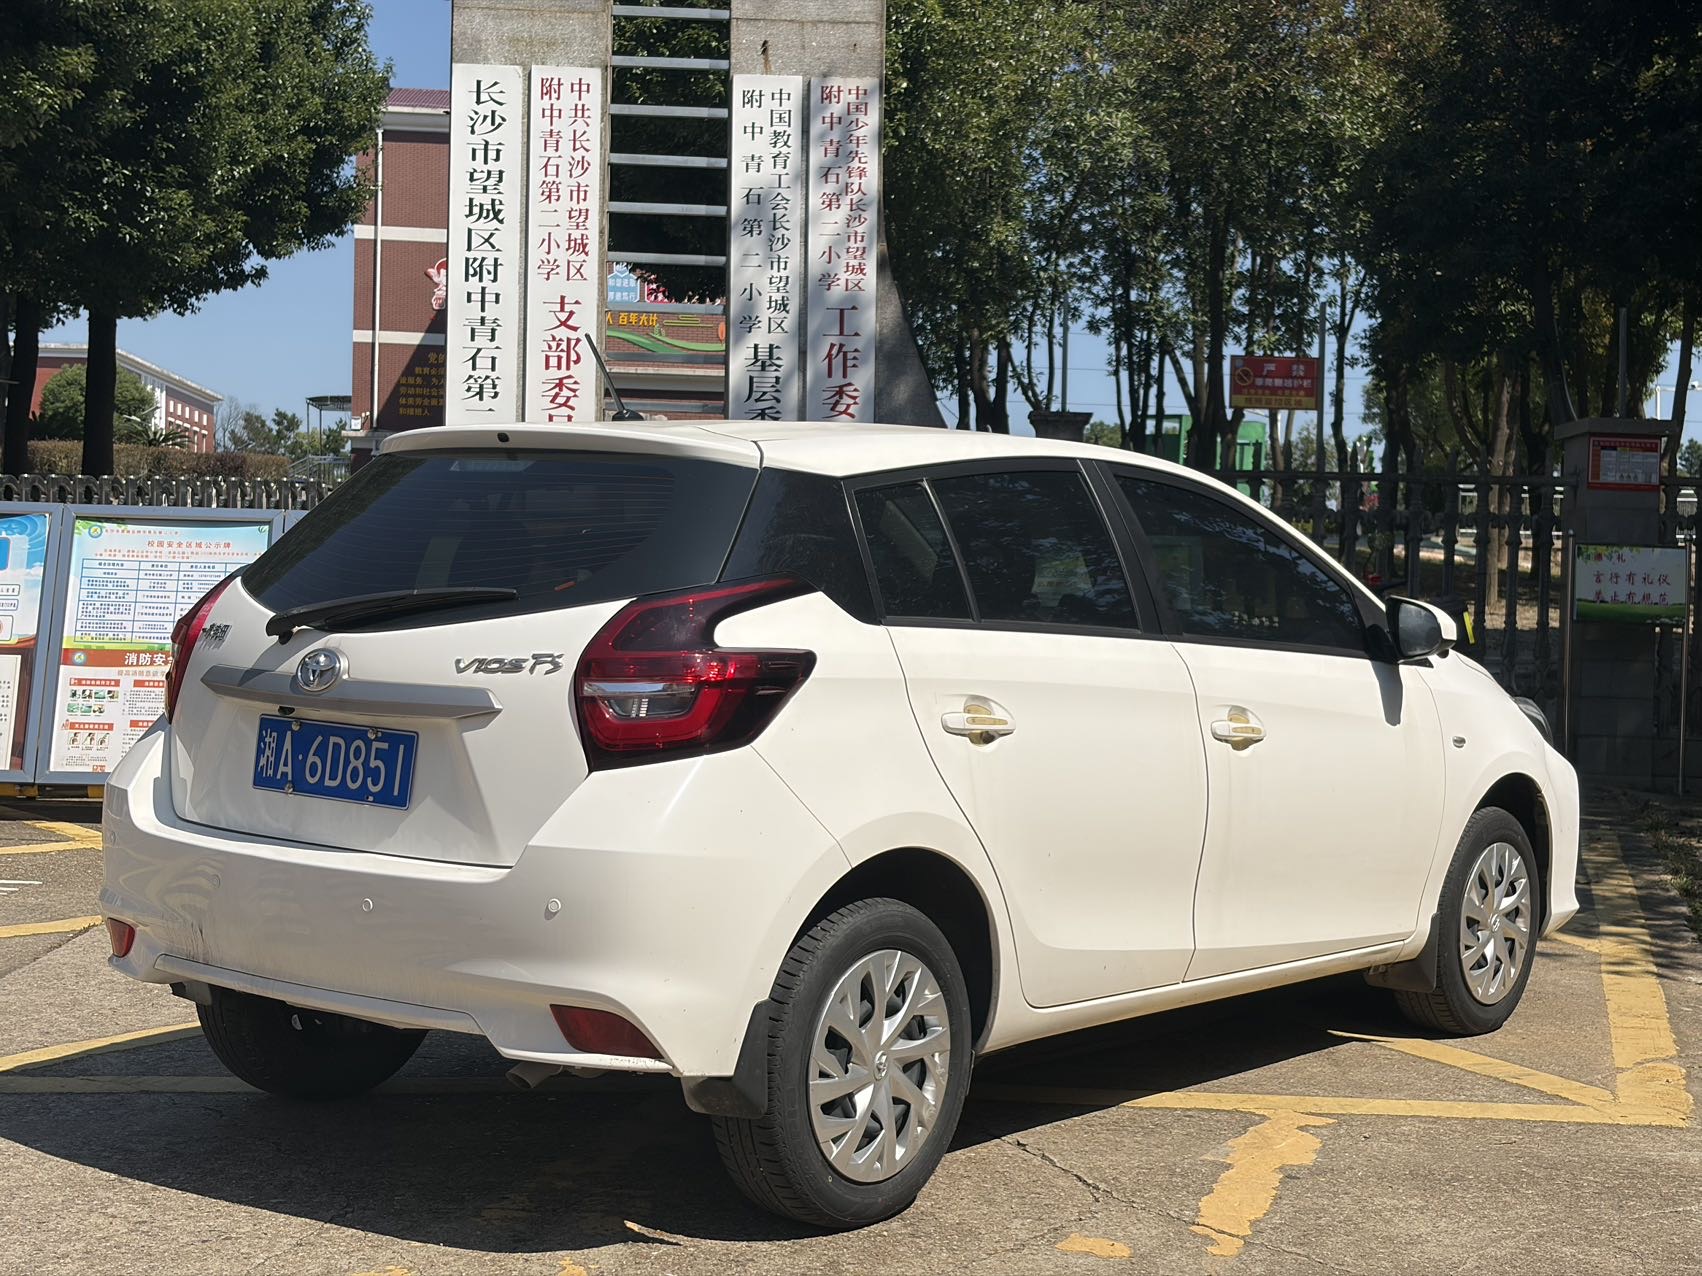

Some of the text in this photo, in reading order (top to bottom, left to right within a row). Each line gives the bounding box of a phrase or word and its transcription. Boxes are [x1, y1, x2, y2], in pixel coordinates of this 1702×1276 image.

[536, 77, 564, 282] 附中青石第二小学
[565, 77, 592, 282] 中共长沙市望城区
[739, 89, 766, 335] 附中青石第二小学
[766, 87, 792, 335] 中国教育工会长沙市望城区
[818, 85, 844, 292] 附中青石第二小学
[843, 85, 868, 293] 中国少年先锋队长沙市望城区
[619, 312, 658, 326] 百年大计
[821, 305, 861, 419] 工作委
[147, 539, 232, 549] 校园安全区域公示牌
[1593, 570, 1671, 586] 言行有礼仪
